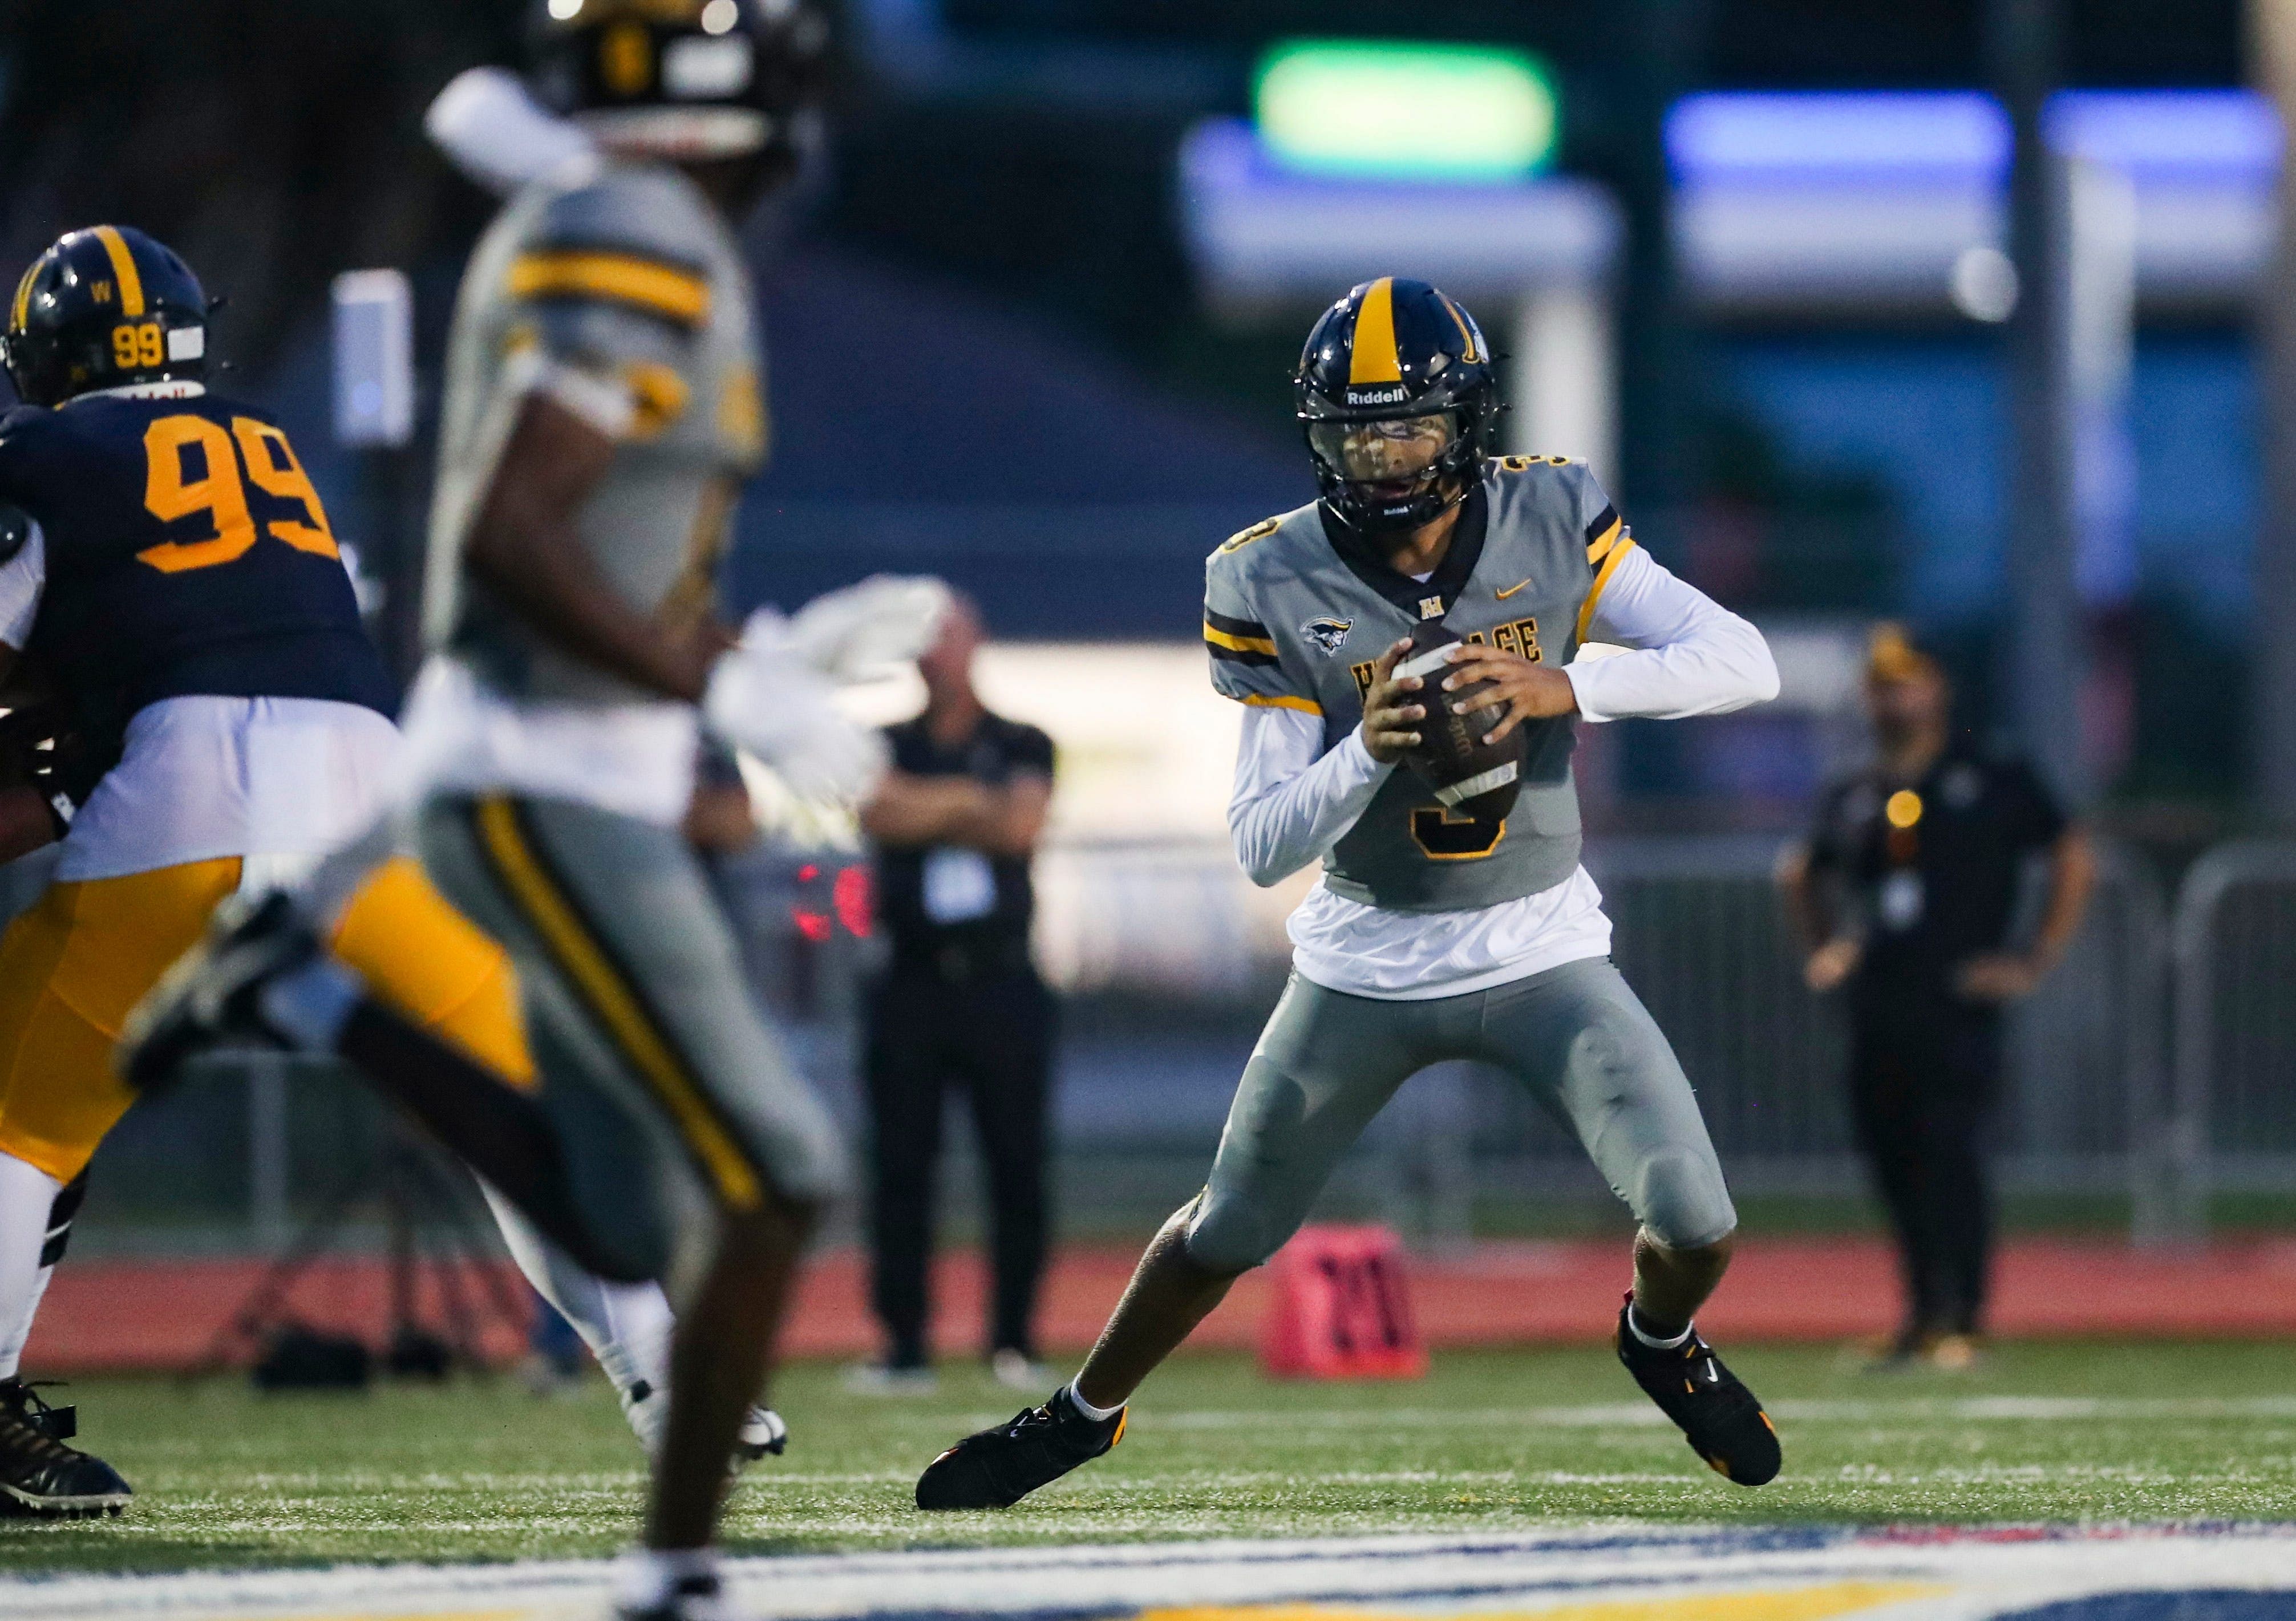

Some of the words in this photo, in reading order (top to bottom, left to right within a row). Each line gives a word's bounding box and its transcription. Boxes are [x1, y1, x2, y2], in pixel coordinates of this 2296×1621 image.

[91, 281, 111, 303] W
[112, 323, 164, 368] 99
[1347, 388, 1404, 405] Riddell
[135, 414, 342, 574] 99
